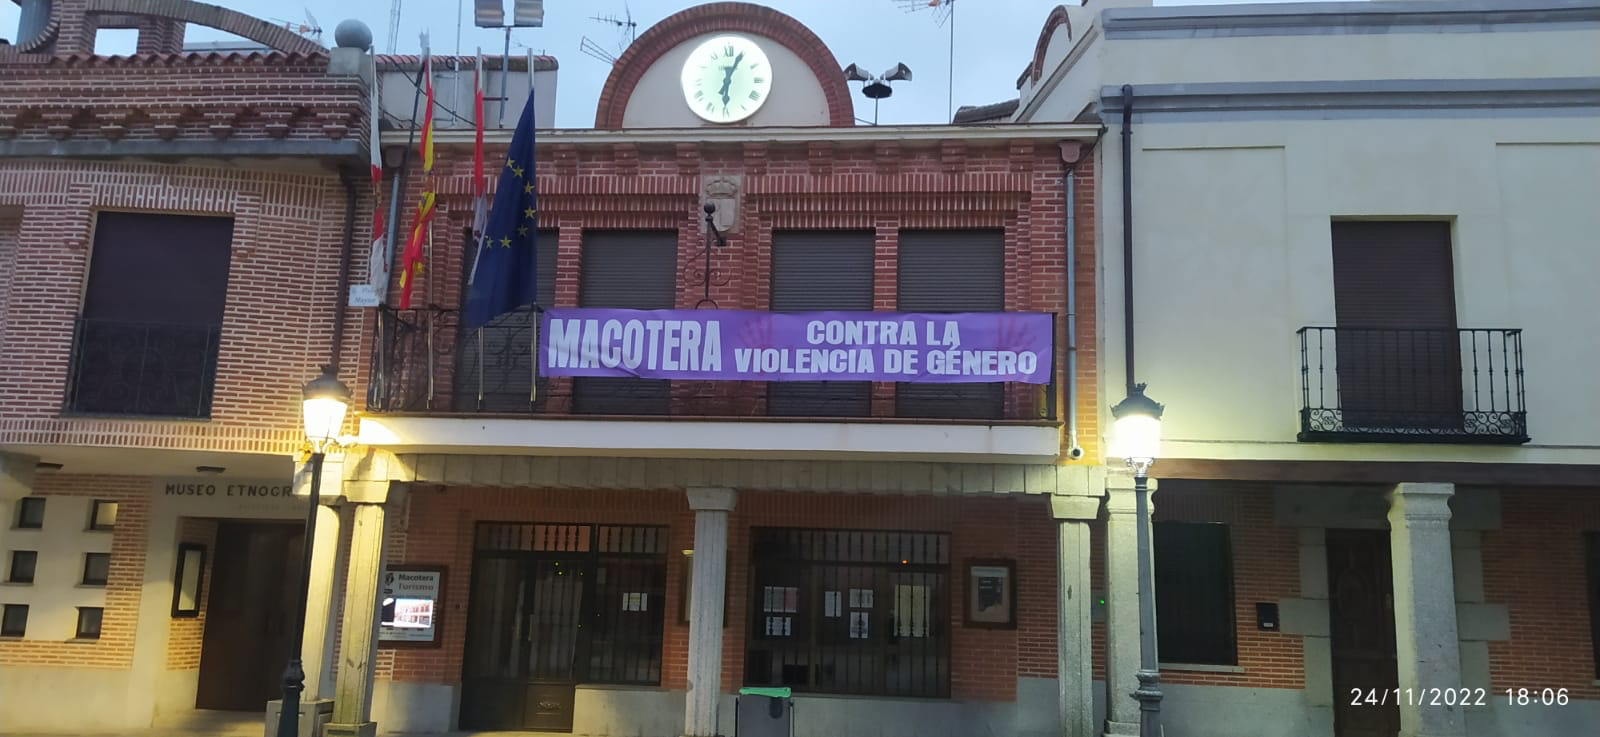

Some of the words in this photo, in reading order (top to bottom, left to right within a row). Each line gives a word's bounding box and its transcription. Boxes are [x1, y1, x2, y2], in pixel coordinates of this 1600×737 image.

[806, 320, 917, 346] CONTRA
[926, 320, 961, 346] LA
[548, 318, 722, 372] MACOTERA
[734, 348, 875, 374] VIOLENCIA
[883, 348, 918, 375] DE
[926, 344, 1037, 376] GÉNERO
[165, 484, 216, 496] MUSEO
[227, 484, 292, 497] ETNOGR
[398, 573, 434, 582] Macotera
[398, 583, 434, 591] Turismo
